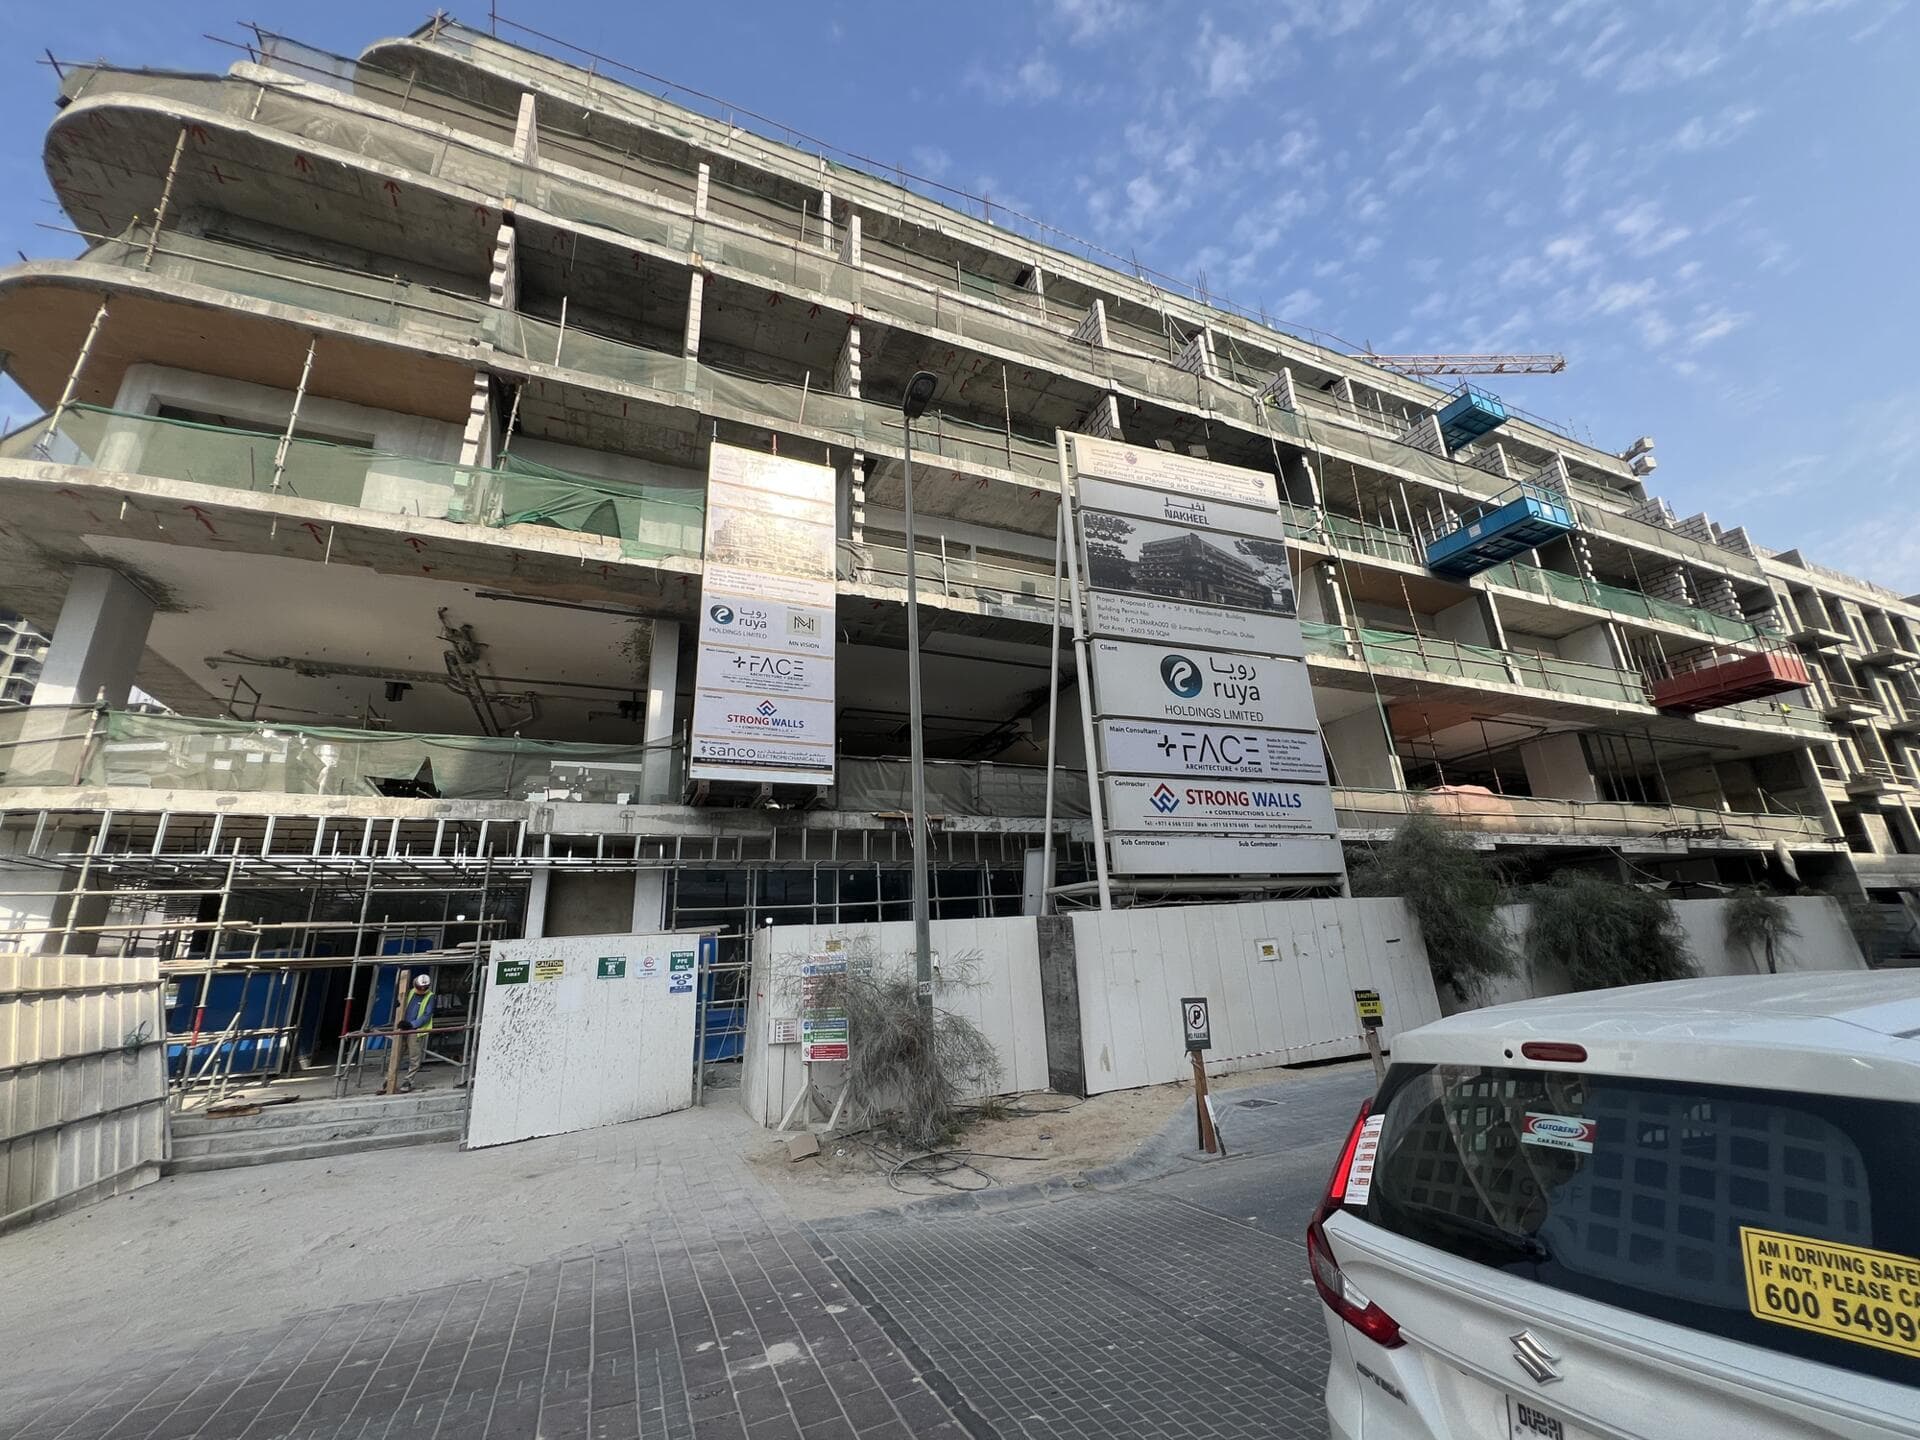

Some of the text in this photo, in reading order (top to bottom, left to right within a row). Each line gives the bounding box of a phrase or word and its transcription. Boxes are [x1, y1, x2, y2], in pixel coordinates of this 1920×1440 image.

[1164, 509, 1210, 526] NAKHEEL
[739, 617, 767, 630] ruya
[709, 626, 768, 639] HOLDINGS LIMITED
[799, 641, 820, 649] VISION
[1099, 643, 1118, 651] Client
[1209, 656, 1257, 681] رويا
[1213, 681, 1261, 706] ruya
[1165, 704, 1264, 722] HOLDINGS LIMITED
[727, 713, 805, 729] STRONG WALLS
[1109, 725, 1125, 733] Main
[1126, 727, 1158, 735] Consultant
[709, 745, 756, 759] sanco
[1185, 763, 1233, 772] ARCHITECTURE
[1240, 766, 1263, 774] DESIGN
[1114, 780, 1146, 788] Contractor
[1186, 788, 1302, 808] STRONG WALLS
[1120, 838, 1133, 846] Sub
[1134, 839, 1166, 847] Contractor
[1536, 1122, 1580, 1135] AUTORENT
[1551, 1139, 1575, 1147] RENTAL
[1758, 1239, 1781, 1258] AM
[1784, 1244, 1791, 1260] I
[1795, 1246, 1866, 1275] DRIVING
[1759, 1259, 1773, 1276] IF
[1779, 1263, 1818, 1290] NOT,
[1822, 1271, 1893, 1303] PLEASE
[1764, 1282, 1920, 1343] 600 5499
